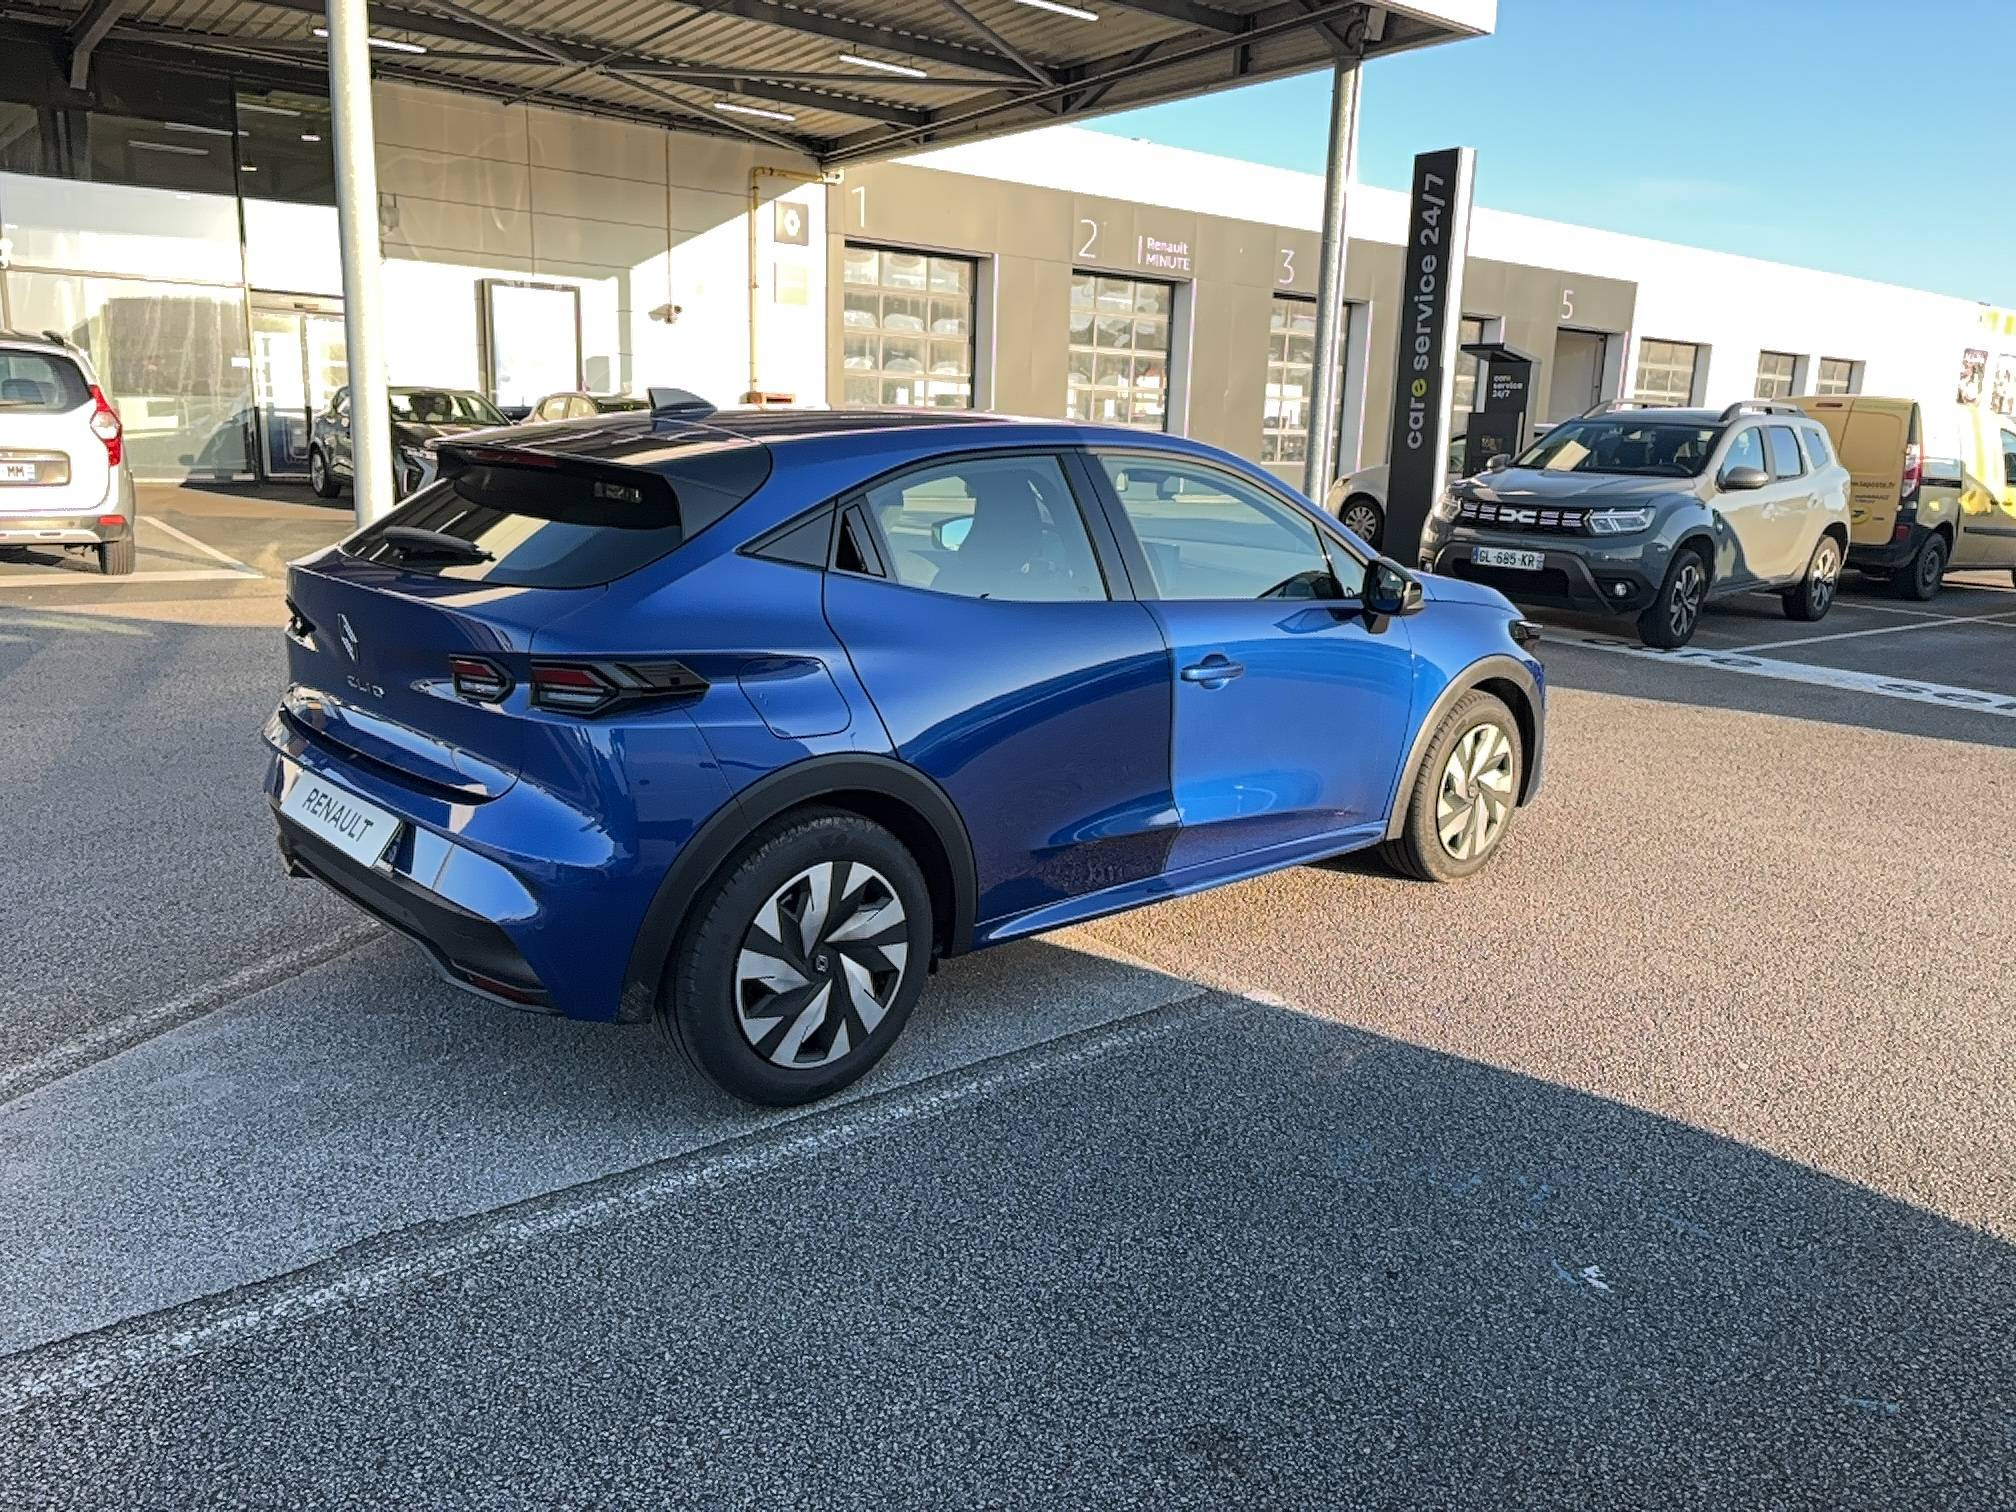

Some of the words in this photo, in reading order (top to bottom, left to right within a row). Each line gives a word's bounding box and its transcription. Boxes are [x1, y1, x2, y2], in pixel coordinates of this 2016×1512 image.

[851, 186, 866, 228] 1
[1420, 173, 1446, 246] 24/7
[1078, 219, 1098, 259] 2
[1147, 237, 1189, 255] Renault
[1145, 253, 1191, 271] MINUTE
[1279, 249, 1296, 284] 3
[1413, 255, 1438, 371] service
[1561, 290, 1575, 319] 5
[1407, 378, 1428, 449] care
[347, 675, 384, 698] CLIO
[302, 788, 374, 843] RENAULT
